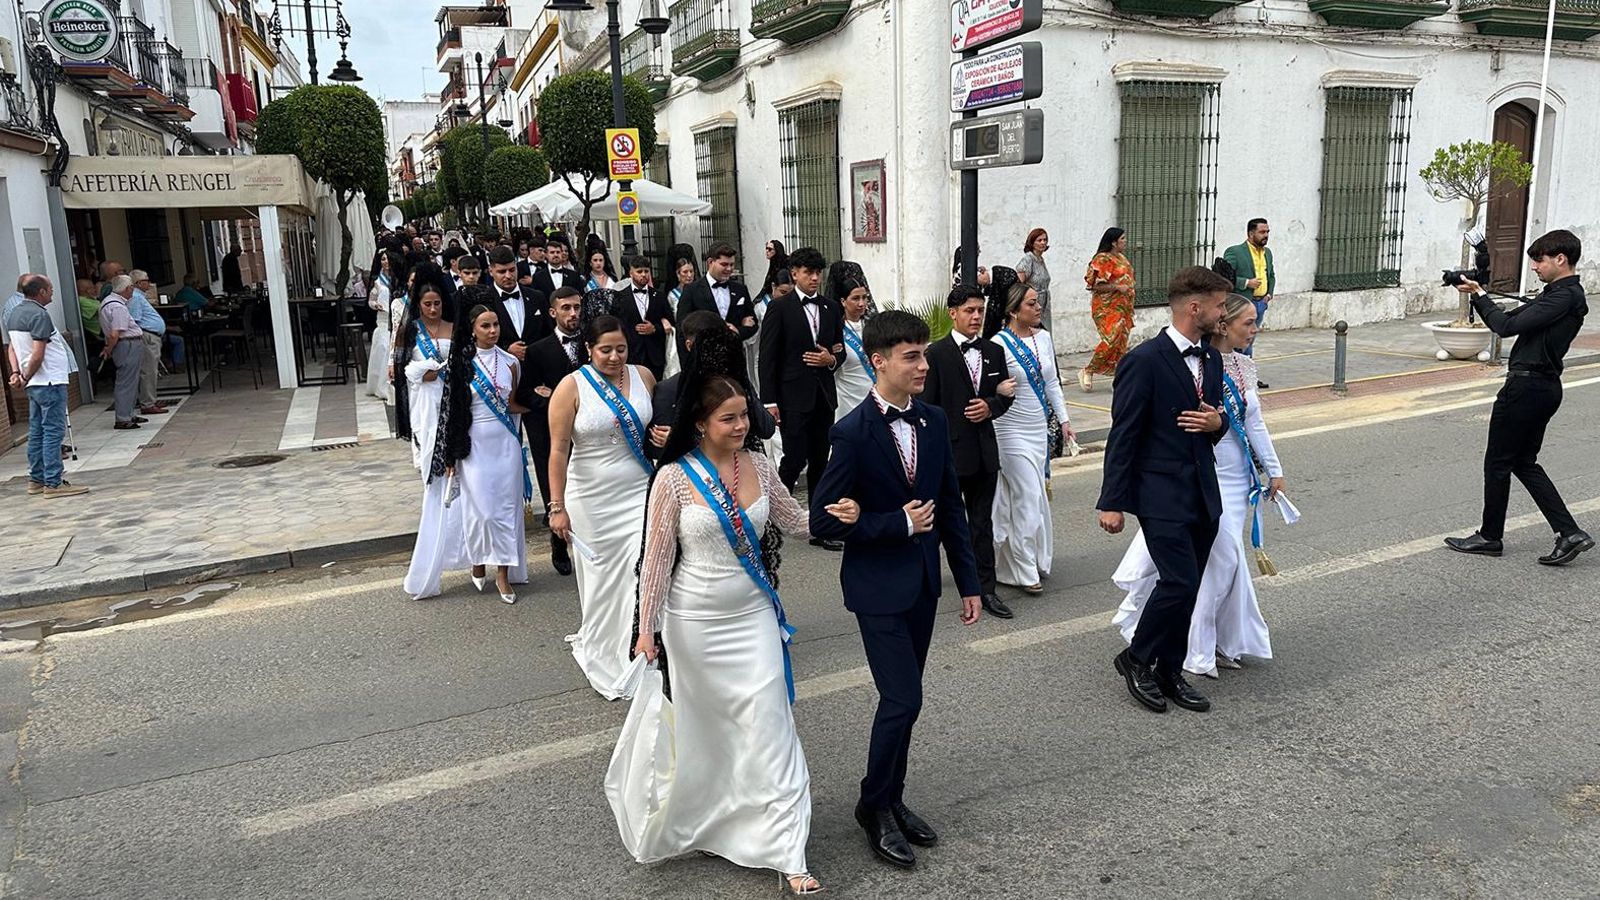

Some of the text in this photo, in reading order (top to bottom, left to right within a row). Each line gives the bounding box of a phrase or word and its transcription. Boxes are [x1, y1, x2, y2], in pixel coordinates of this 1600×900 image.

[82, 3, 97, 14] BEER
[52, 21, 106, 32] Heineken
[60, 37, 105, 52] PREMIUM QUALITY
[990, 64, 997, 73] DE
[997, 57, 1022, 71] AZULEJOS
[997, 70, 1015, 82] BAÑOS
[1001, 120, 1023, 131] SAN JUAN
[1007, 132, 1015, 142] DEL
[1002, 144, 1020, 153] PUERTO
[59, 170, 236, 192] CAFETERÍA RENGEL
[612, 397, 628, 417] DAMA
